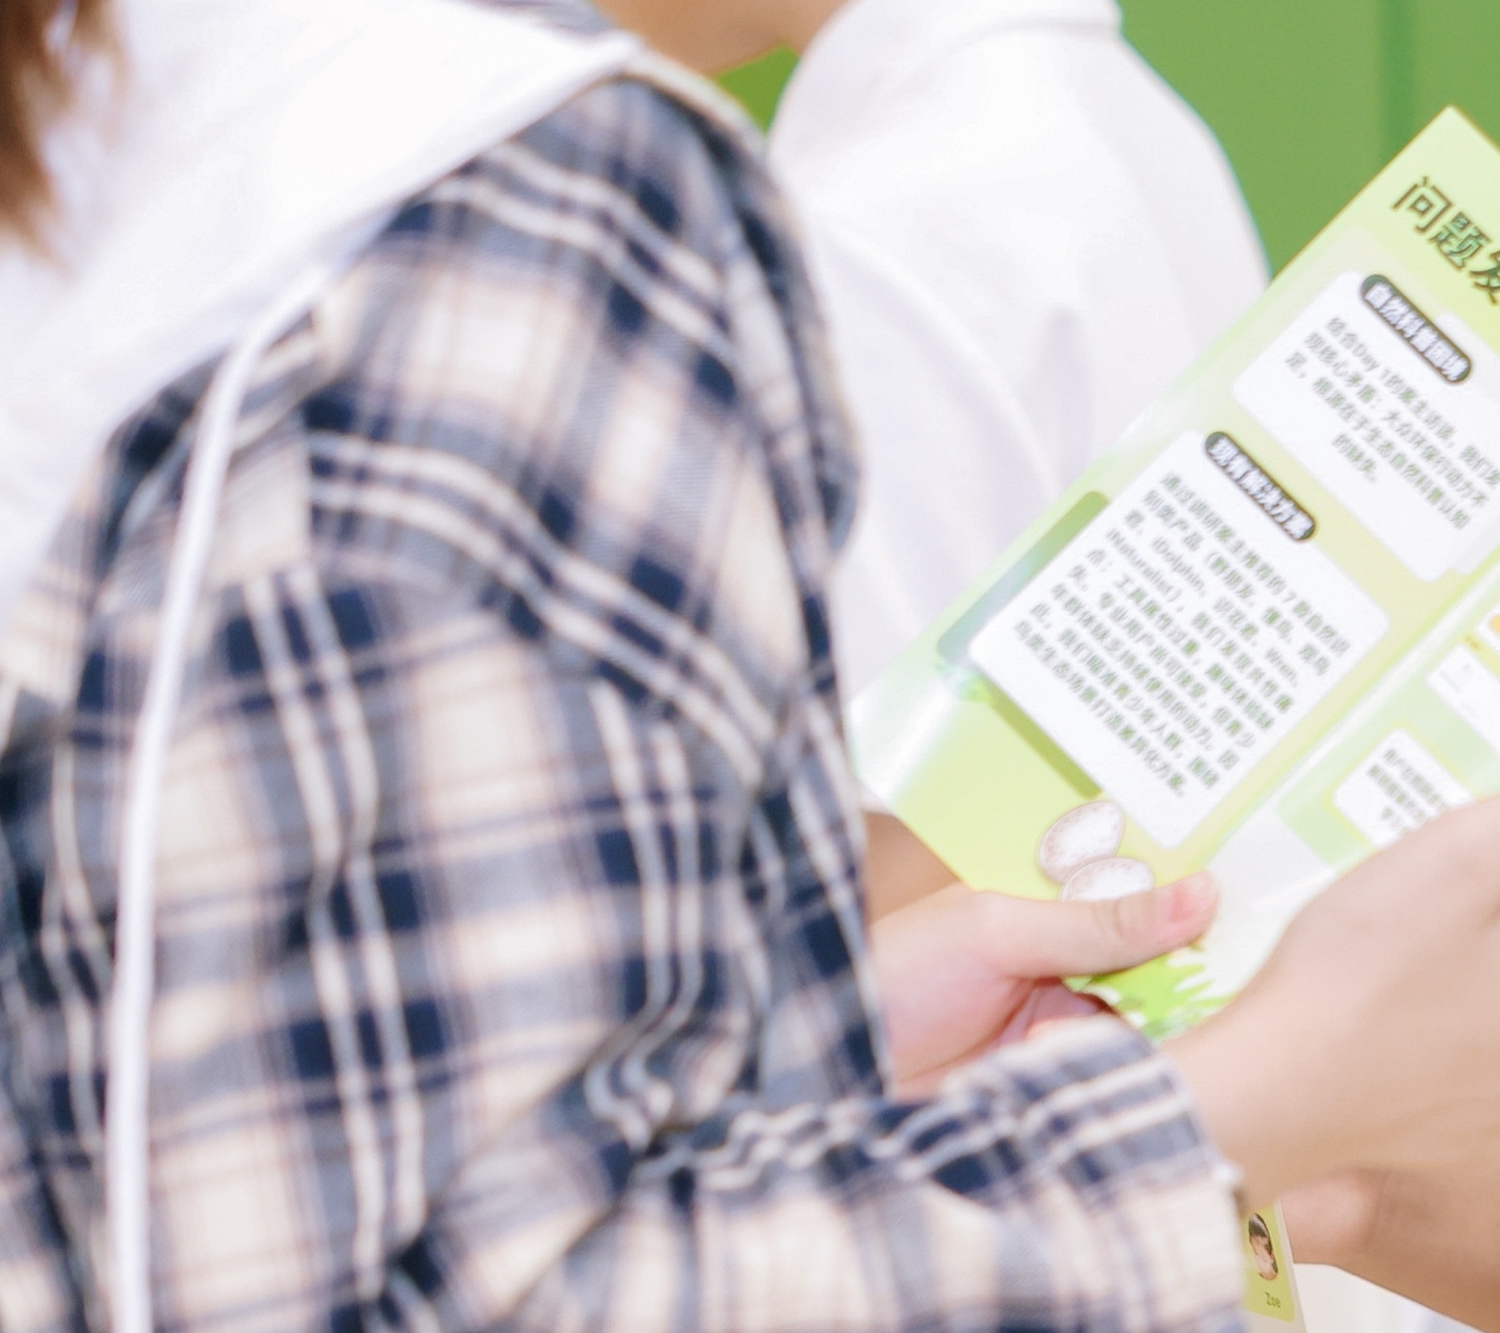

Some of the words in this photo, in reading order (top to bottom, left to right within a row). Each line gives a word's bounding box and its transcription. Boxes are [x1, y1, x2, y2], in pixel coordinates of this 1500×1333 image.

[1363, 279, 1471, 383] 自然科普困境
[1206, 435, 1316, 542] 现有解决方案
